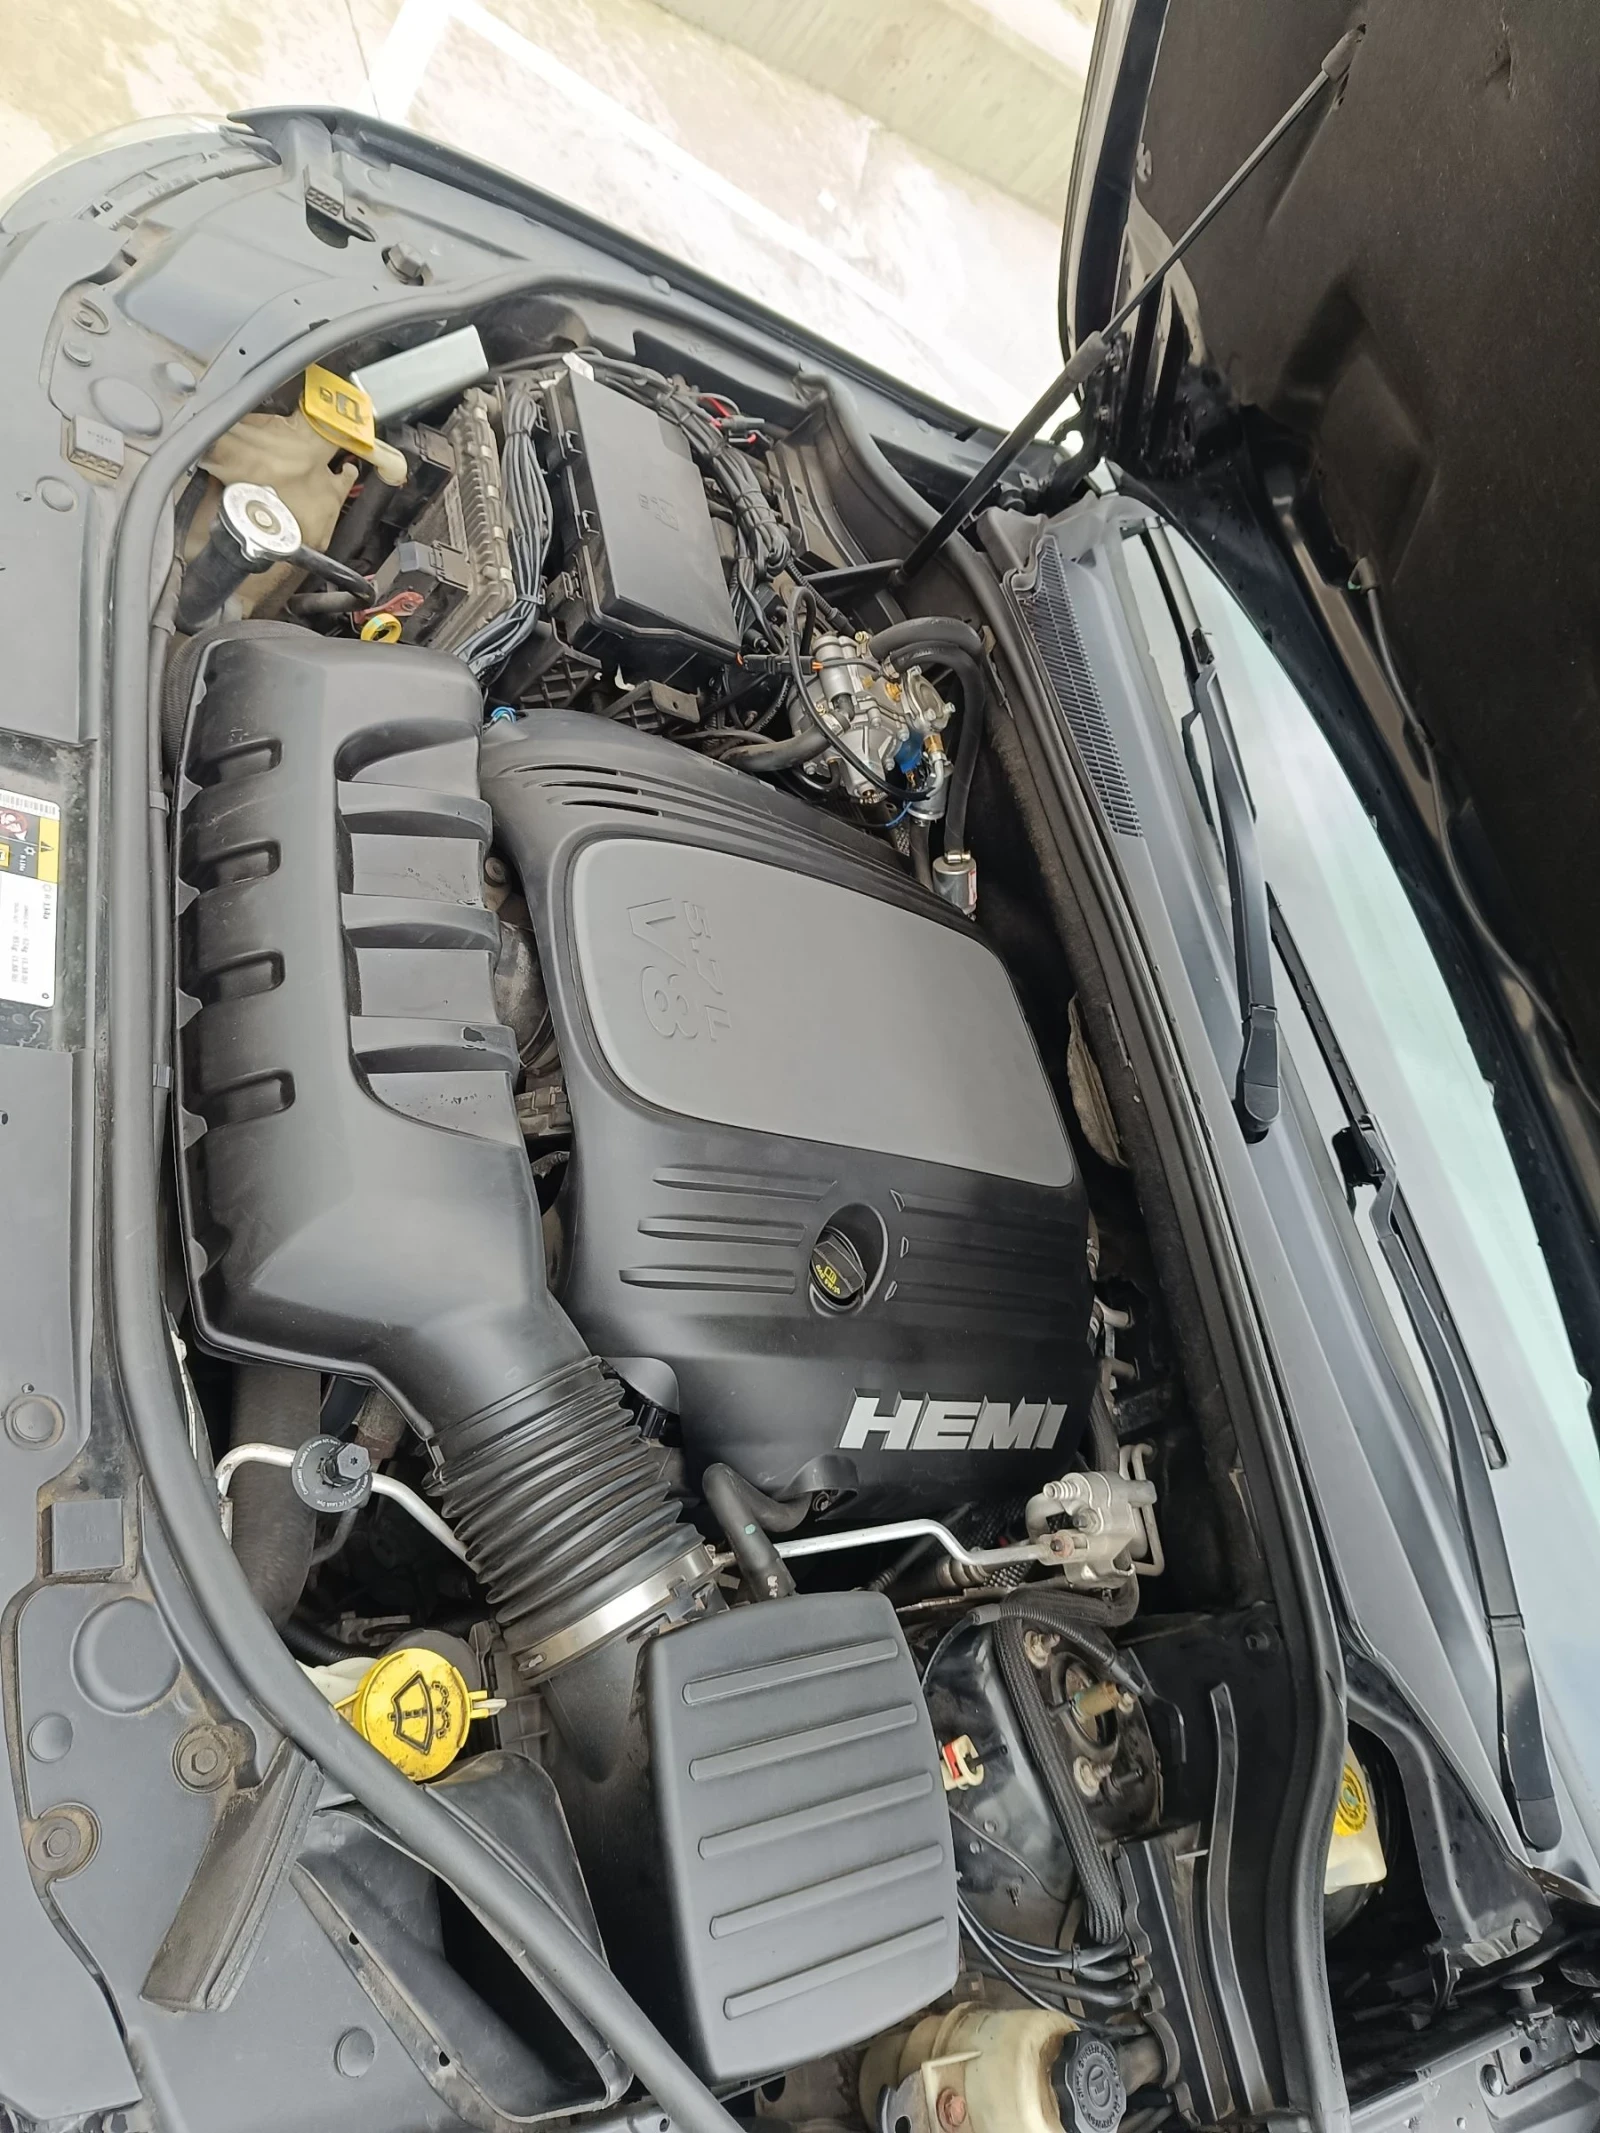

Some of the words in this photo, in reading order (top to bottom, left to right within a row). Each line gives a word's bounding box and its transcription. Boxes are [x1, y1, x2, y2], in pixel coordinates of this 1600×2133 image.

[626, 898, 698, 1039] V8
[682, 900, 732, 1042] 5.7L
[836, 1389, 1068, 1450] HEMI
